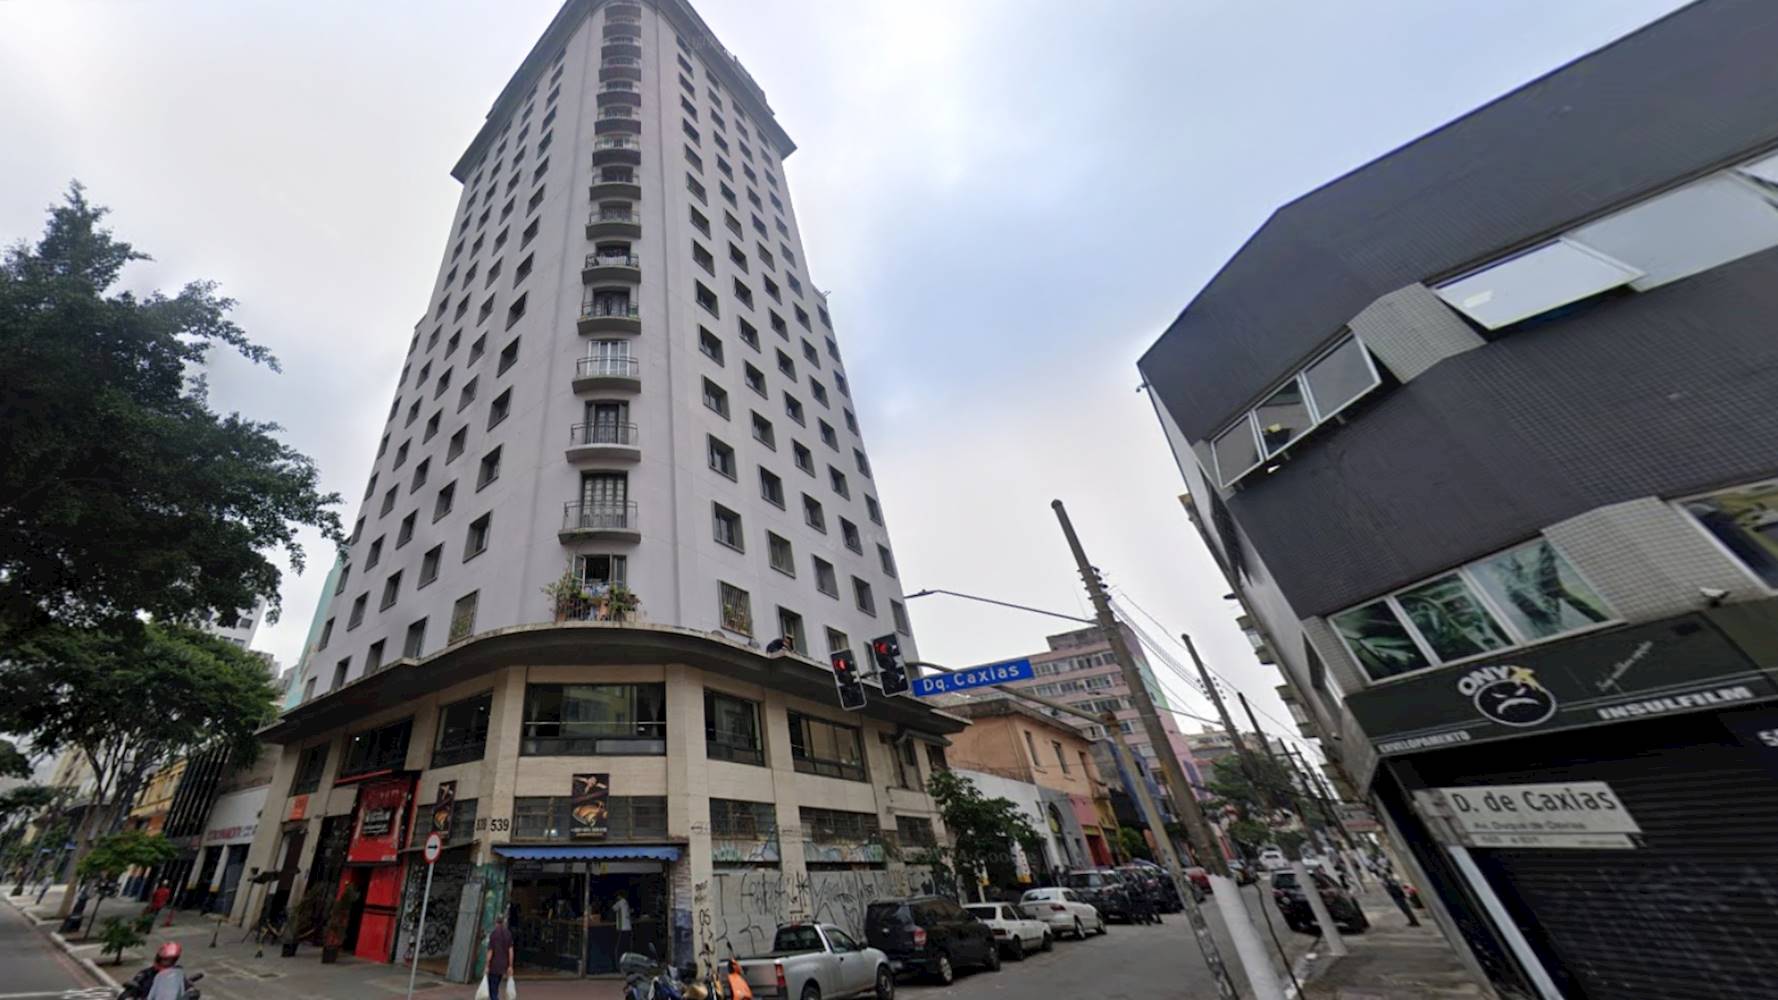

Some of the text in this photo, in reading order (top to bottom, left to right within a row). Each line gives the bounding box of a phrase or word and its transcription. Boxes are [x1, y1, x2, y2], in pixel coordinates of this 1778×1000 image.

[923, 665, 1019, 692] Dq. Caxias
[1597, 686, 1755, 720] INSULFILM
[1452, 787, 1617, 813] D. de Caxias
[490, 818, 510, 832] 539
